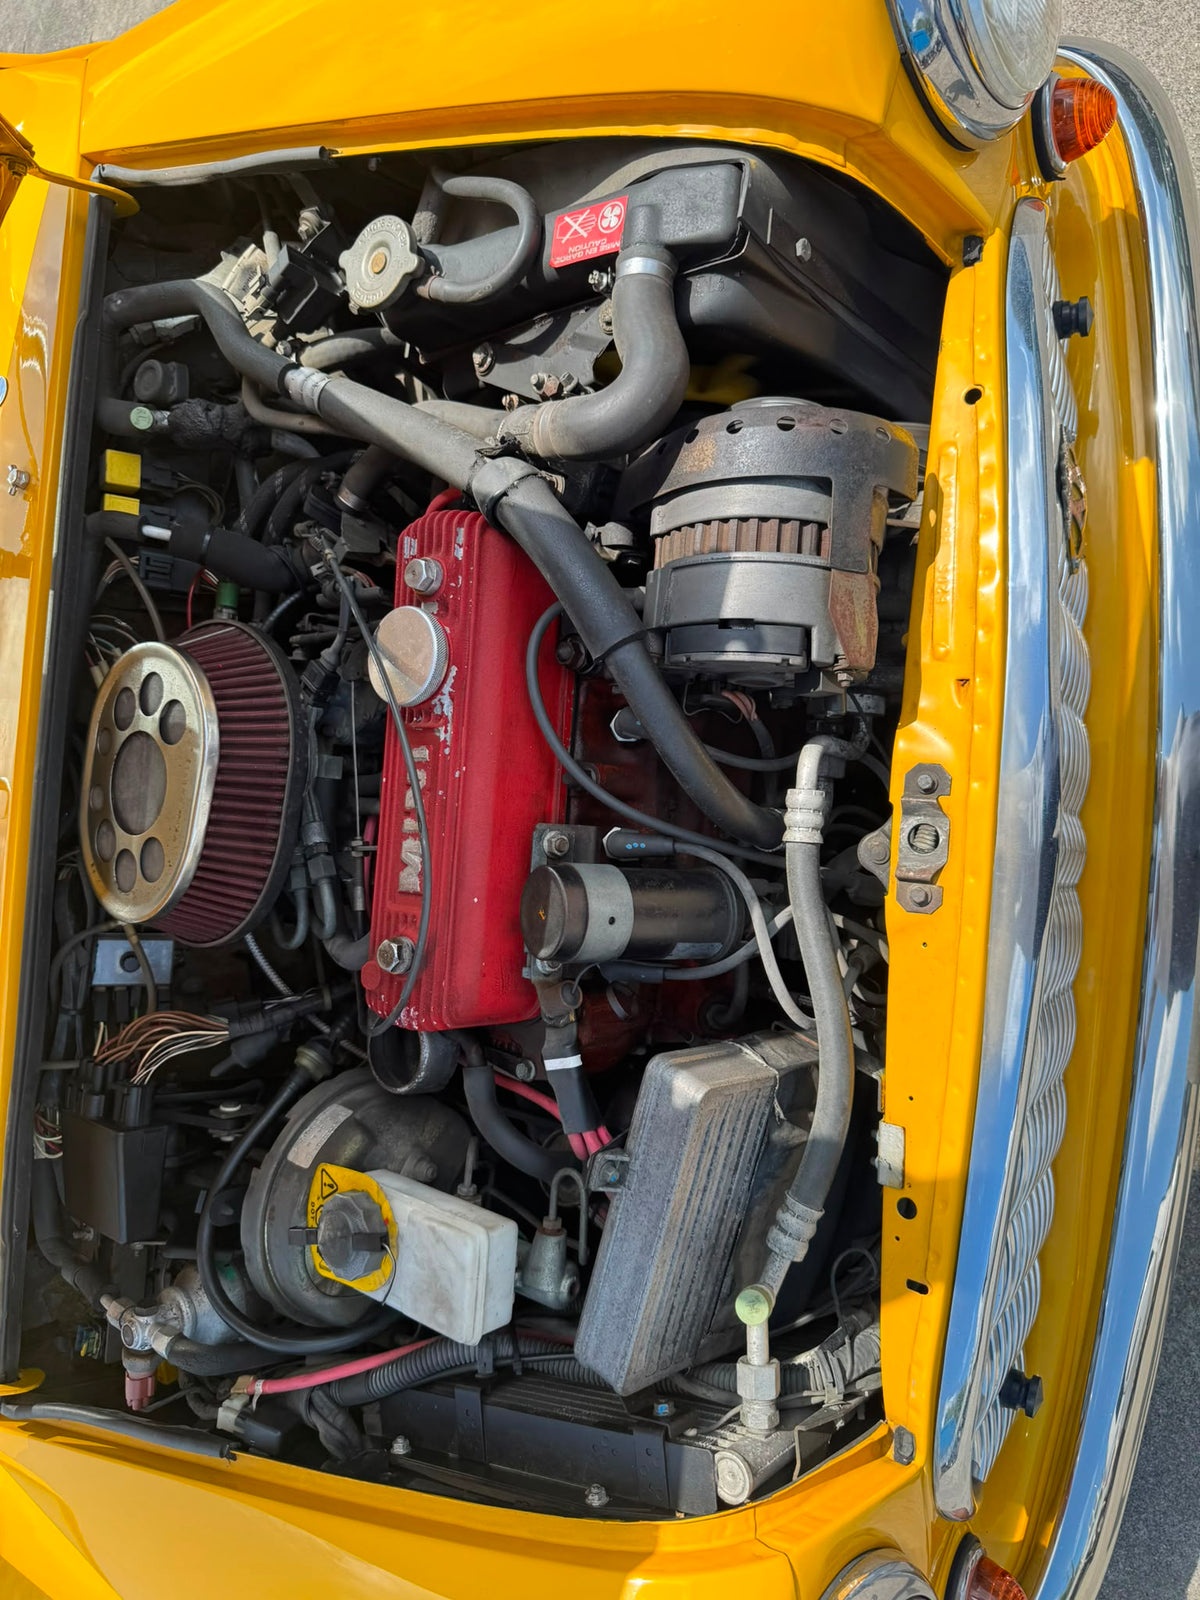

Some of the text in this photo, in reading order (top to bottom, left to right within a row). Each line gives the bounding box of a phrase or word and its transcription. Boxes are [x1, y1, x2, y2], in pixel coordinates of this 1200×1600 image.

[553, 240, 621, 265] MISE EN GARDE
[568, 238, 607, 253] CAUTION
[398, 744, 430, 894] MINI
